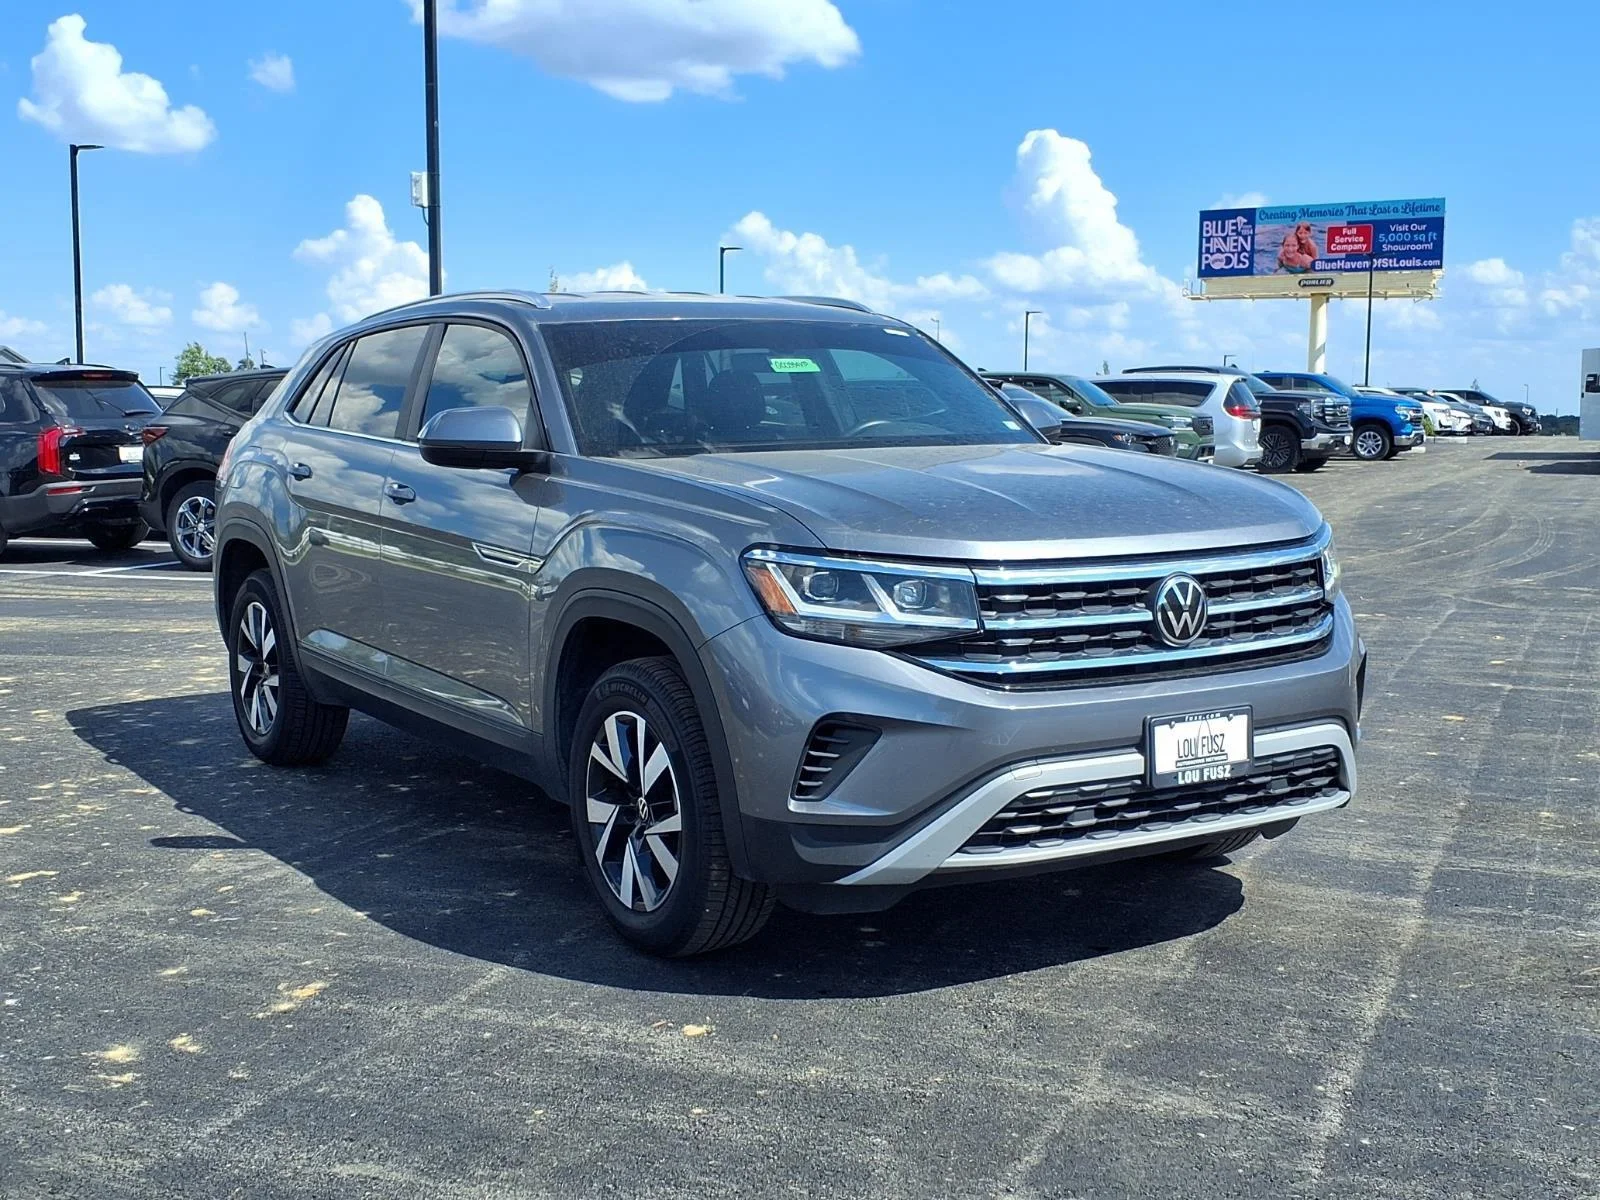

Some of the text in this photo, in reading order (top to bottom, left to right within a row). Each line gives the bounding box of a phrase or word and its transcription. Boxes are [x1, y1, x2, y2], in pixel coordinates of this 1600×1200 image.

[1259, 201, 1441, 222] Creating Memories That Last a Lifetime
[1203, 219, 1237, 237] BLUE
[1343, 227, 1357, 235] Full
[1390, 223, 1427, 232] Visit Our
[1203, 236, 1251, 253] HAVEN
[1335, 235, 1364, 243] Service
[1379, 231, 1438, 244] 5,000 sq ft
[1331, 243, 1367, 252] Company
[1383, 242, 1433, 252] Showroom!
[1202, 252, 1250, 270] POOLS
[1177, 733, 1226, 759] LOU FUSZ
[1178, 764, 1232, 785] LOU FUSZ
